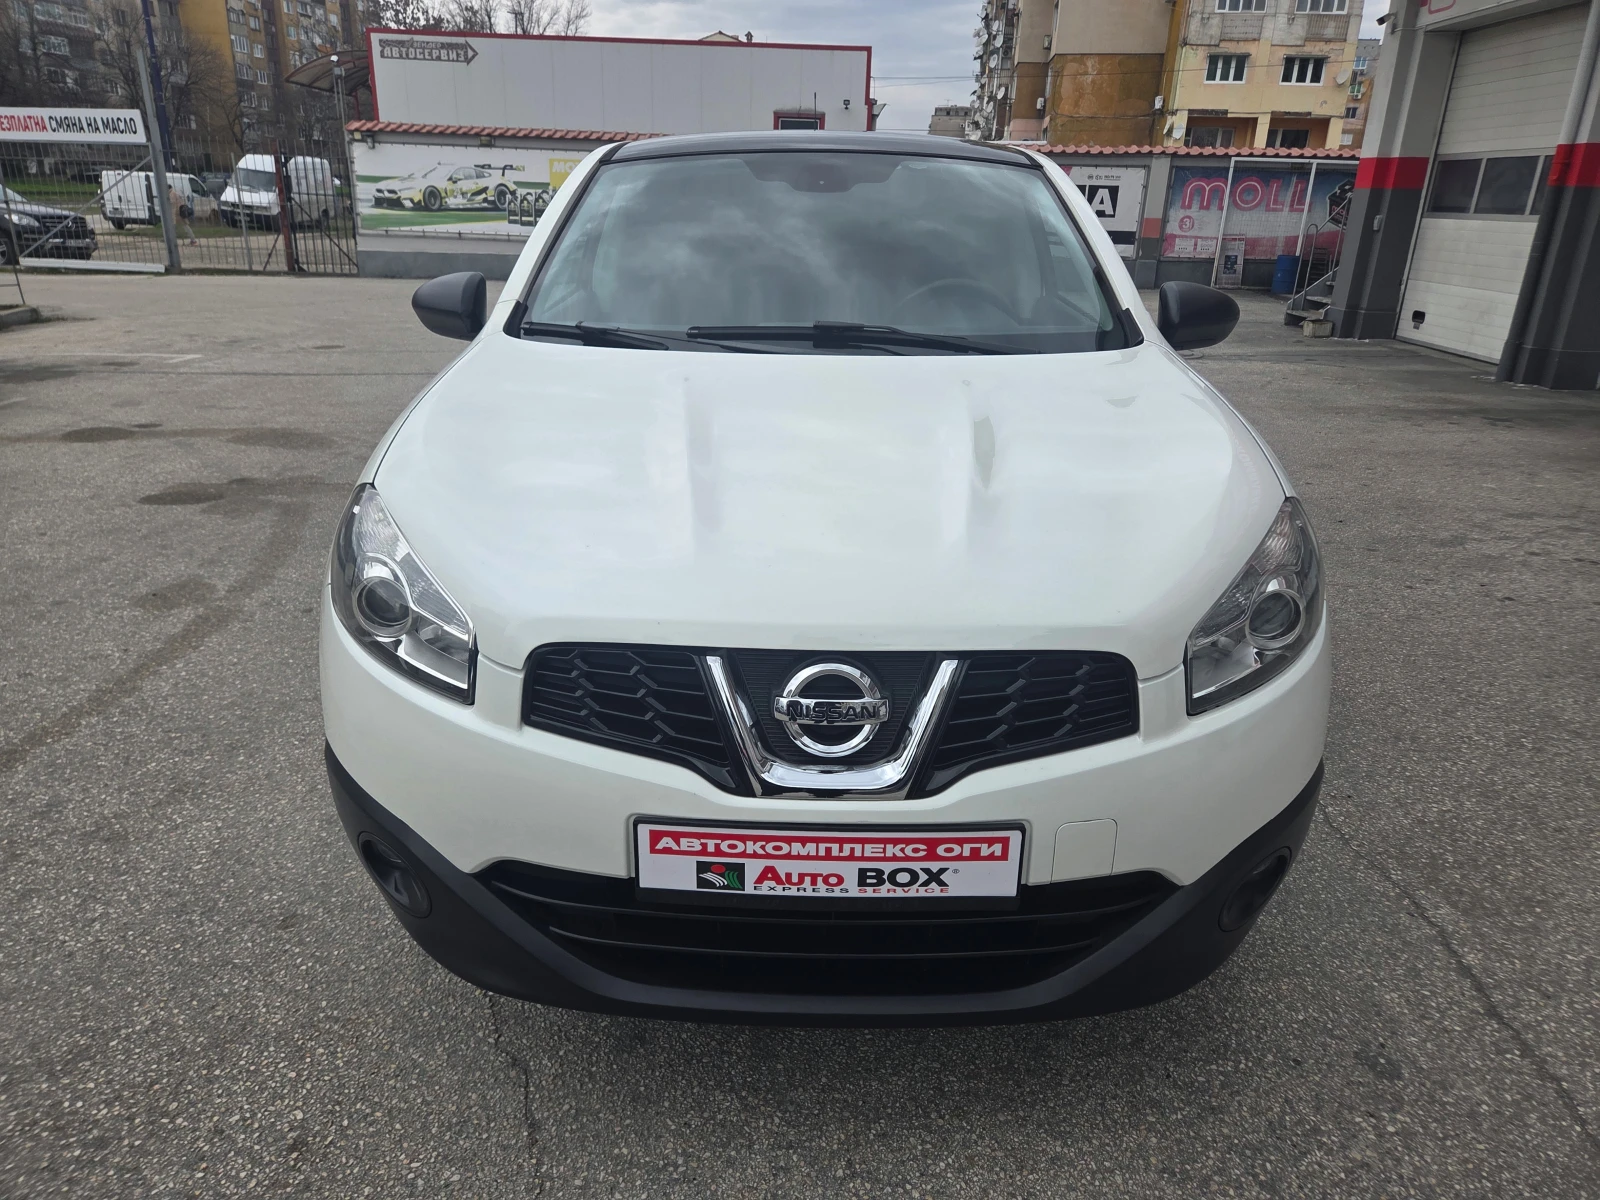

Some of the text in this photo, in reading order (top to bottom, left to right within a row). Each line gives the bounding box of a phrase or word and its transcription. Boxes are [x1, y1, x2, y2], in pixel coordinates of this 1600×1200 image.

[383, 47, 465, 61] АВТОСЕРВИЗ
[0, 115, 137, 135] ЕЗПЛАТНА СМЯНА НА МАСЛО
[552, 161, 579, 173] MO
[1180, 176, 1312, 212] MOLL
[786, 700, 876, 720] NISSAN
[655, 836, 1003, 858] АВТОКОМПЛЕКС ОГИ
[753, 885, 850, 894] EXPRESS
